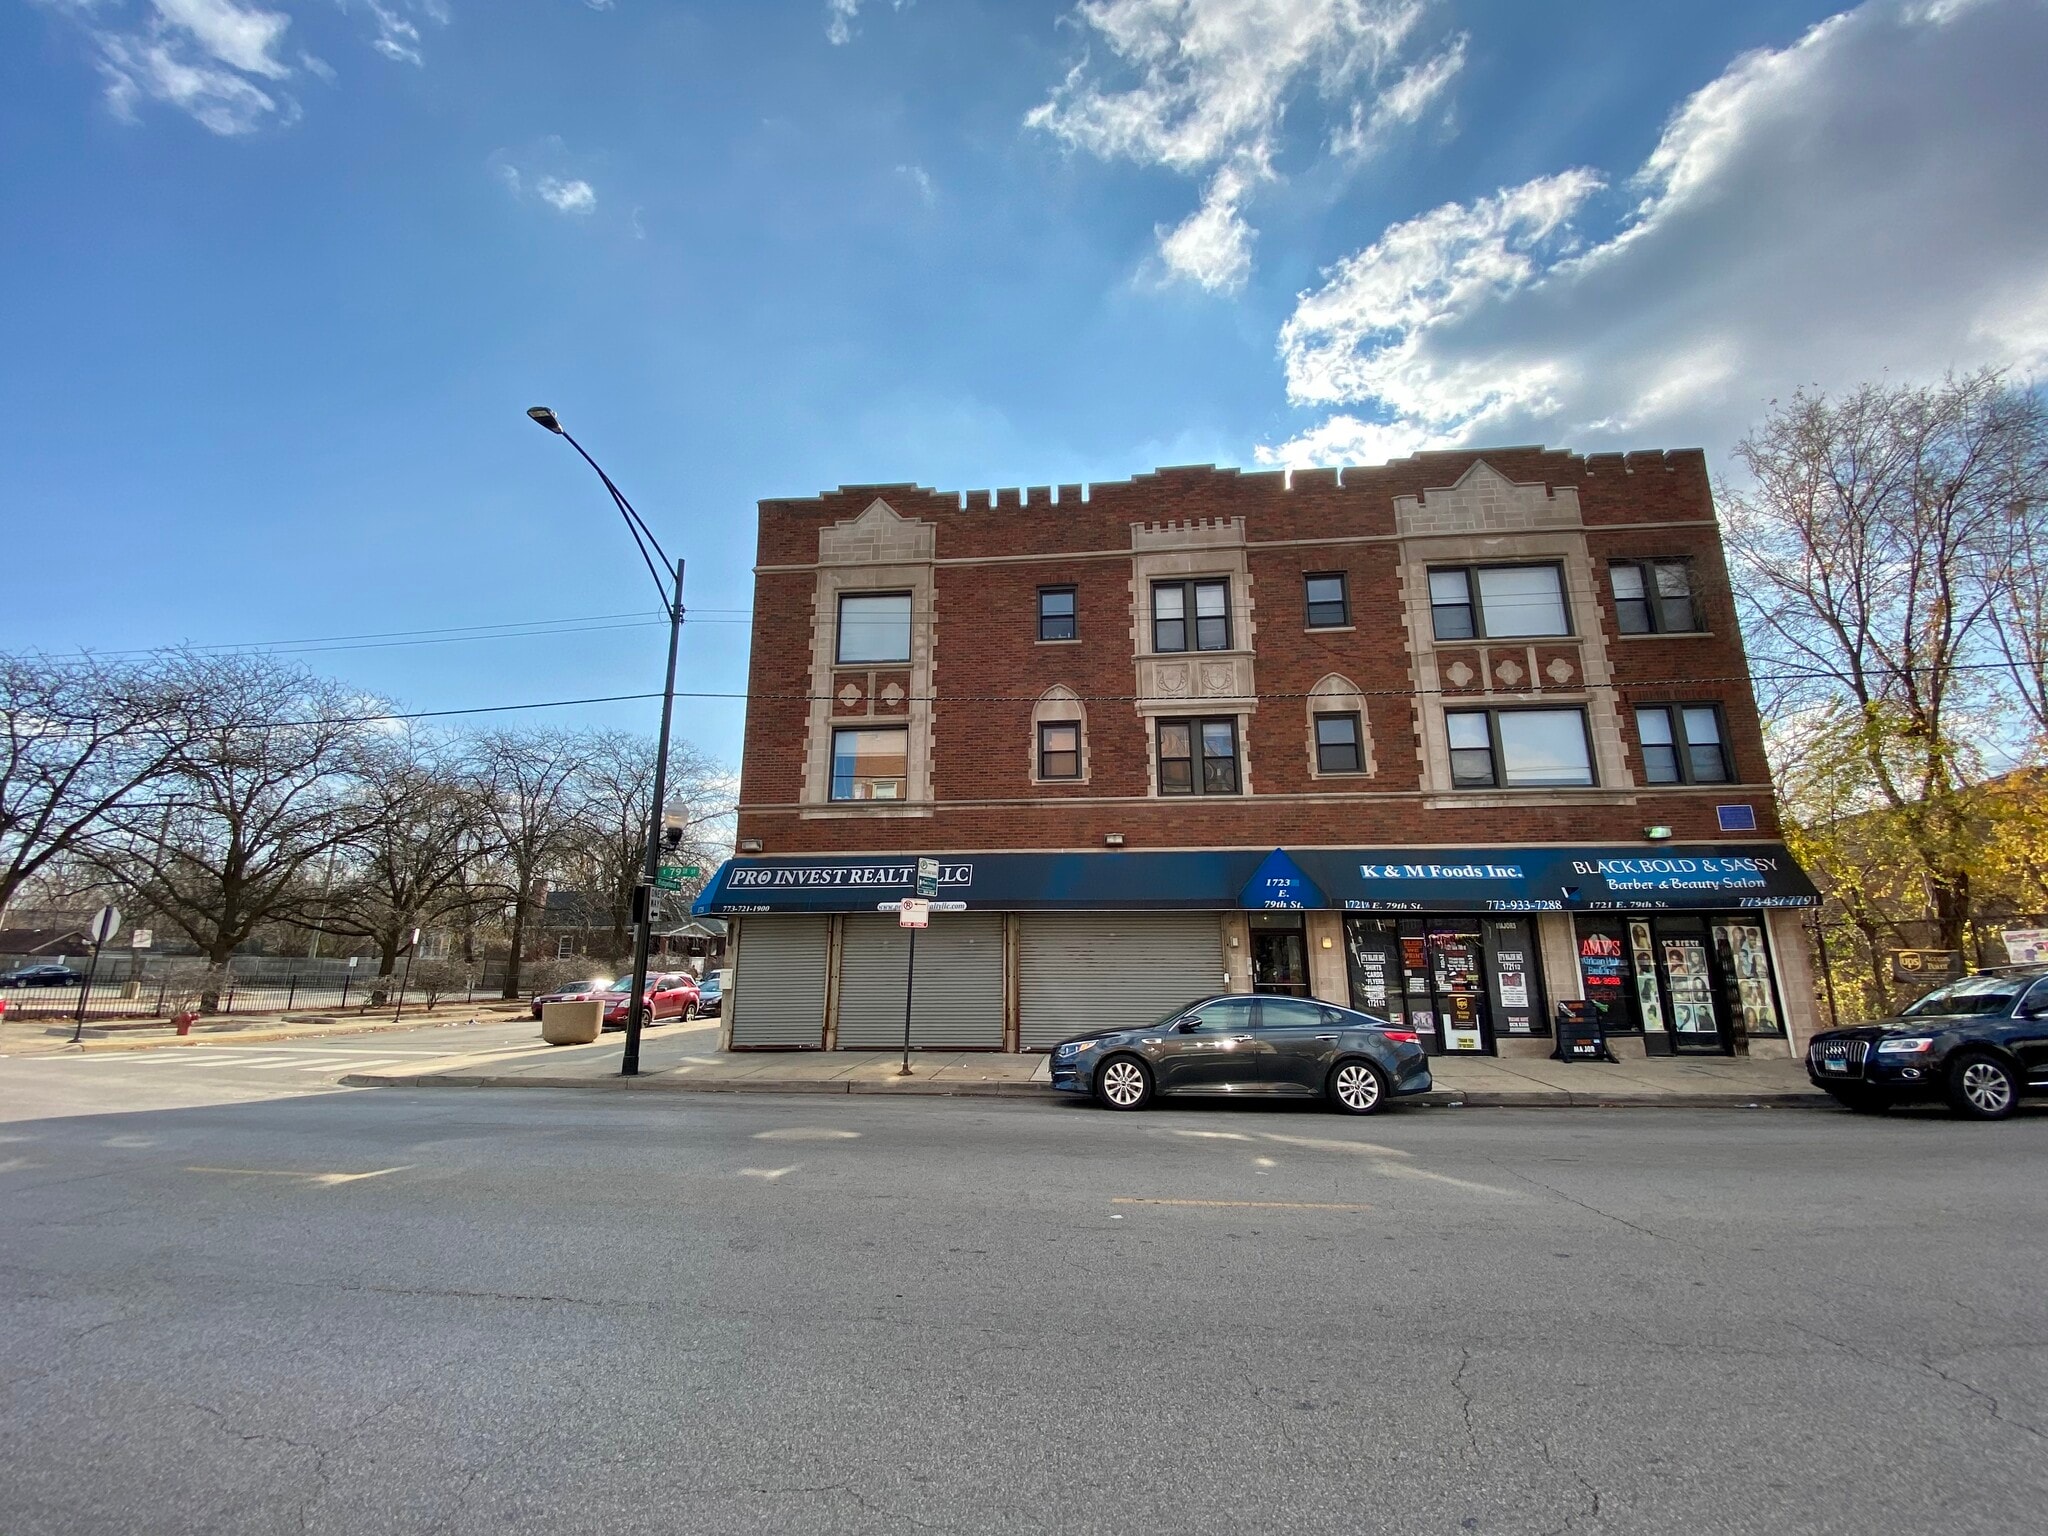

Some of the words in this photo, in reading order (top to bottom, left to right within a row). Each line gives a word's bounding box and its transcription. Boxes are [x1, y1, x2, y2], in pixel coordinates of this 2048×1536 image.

[1361, 864, 1381, 878] K
[1383, 865, 1401, 878] &
[1403, 865, 1425, 878] M
[1427, 864, 1483, 878] Foods
[1484, 864, 1524, 878] Inc.
[1702, 859, 1719, 873] &
[1719, 857, 1779, 872] SASSY
[731, 870, 773, 885] PRO
[773, 869, 848, 885] INVEST
[847, 867, 916, 884] REALT
[1265, 878, 1291, 887] 1723
[1606, 878, 1654, 890] Barber
[1657, 879, 1669, 889] &
[1669, 877, 1720, 891] Beauty
[1721, 876, 1768, 889] Salon
[1277, 889, 1290, 898] E.
[1263, 900, 1288, 909] 79th
[1289, 900, 1305, 909] St.
[1485, 899, 1564, 911] 773-933-7288
[1629, 901, 1653, 909] 79th
[1654, 900, 1670, 908] St.
[1581, 939, 1621, 957] AMY'S
[1901, 957, 1920, 968] ups
